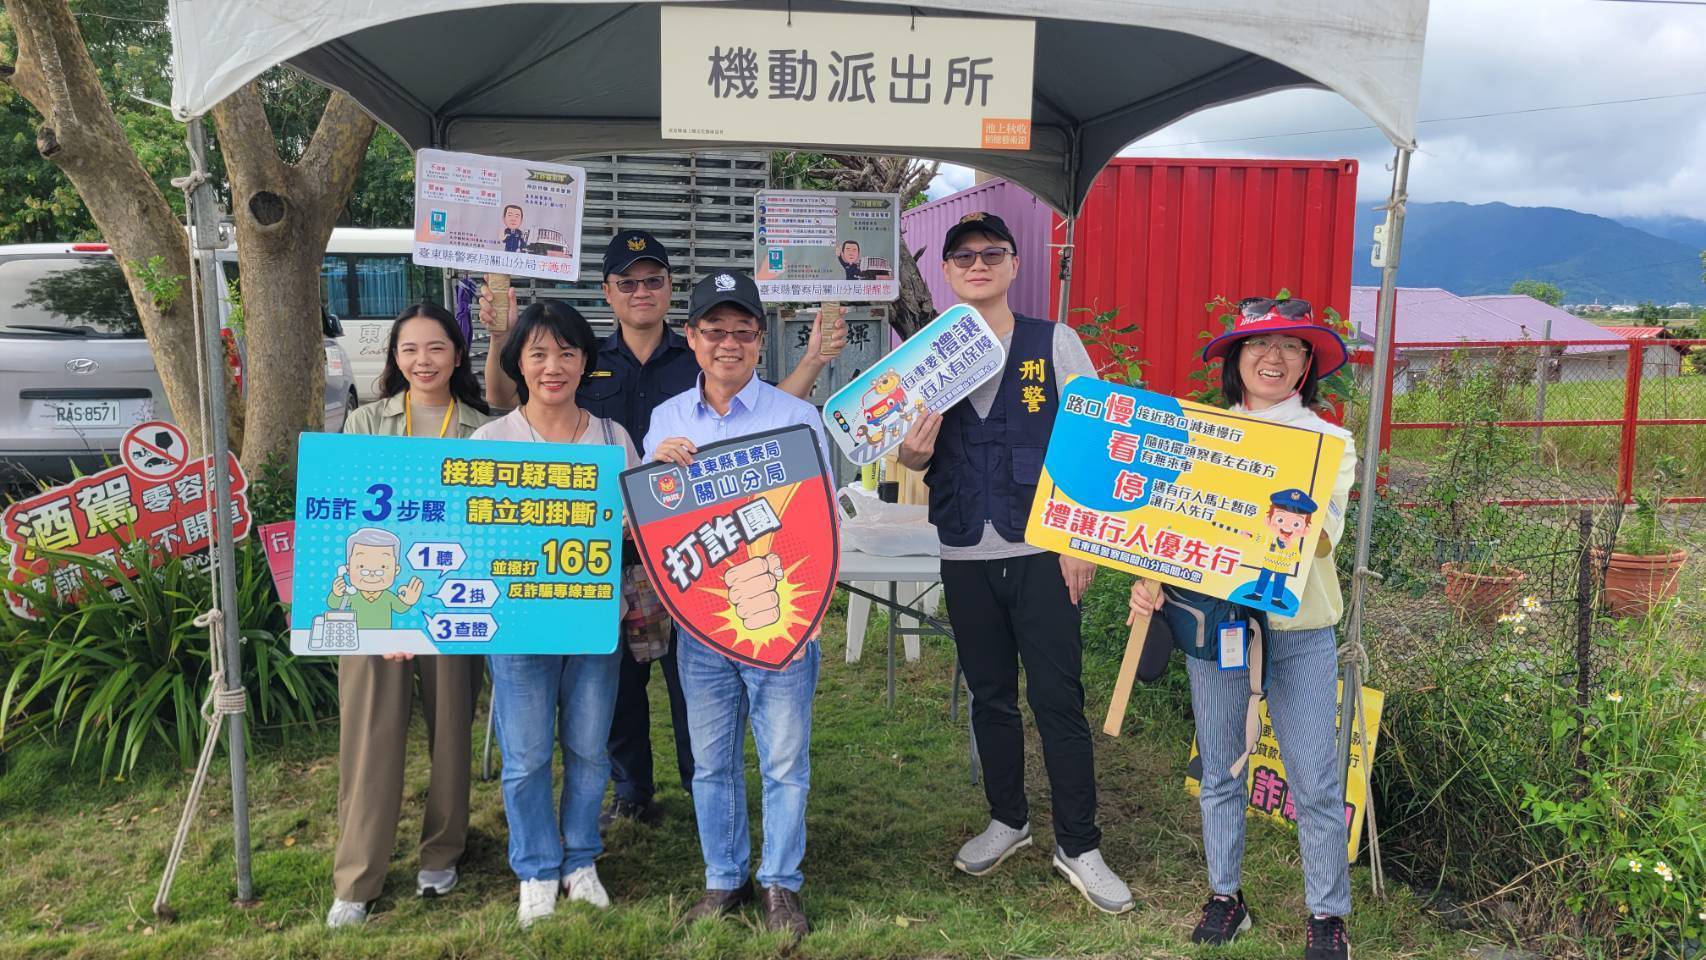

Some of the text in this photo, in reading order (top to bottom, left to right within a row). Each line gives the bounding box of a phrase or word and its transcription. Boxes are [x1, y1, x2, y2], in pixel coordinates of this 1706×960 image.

[707, 45, 993, 107] 機動派出所
[901, 314, 983, 391] 行車要禮讓
[920, 334, 993, 400] 行人有保障
[1019, 358, 1047, 413] 刑警
[1065, 392, 1243, 442] 路口 慢 接近路口減速慢行
[687, 440, 781, 480] 臺東縣警察局
[1108, 431, 1138, 463] 看
[1140, 450, 1193, 473] 有無來車
[1144, 435, 1276, 478] 隨時擺頭察看左右後方
[441, 458, 598, 490] 接獲可疑電話
[693, 462, 786, 504] 關山分局
[1114, 470, 1146, 502] 停
[15, 474, 138, 561] 酒駕
[306, 483, 446, 523] 防詐3步驟
[466, 497, 614, 527] 請立刻掛斷，
[1150, 494, 1215, 521] 讓行人先行
[1153, 479, 1257, 517] 遇有行人馬上暫停
[271, 531, 294, 553] 行
[491, 539, 612, 576] 並撥打 165
[663, 497, 782, 592] 打詐團
[1041, 501, 1241, 575] 禮讓行人優先行
[508, 583, 613, 600] 反詐騙專線查證
